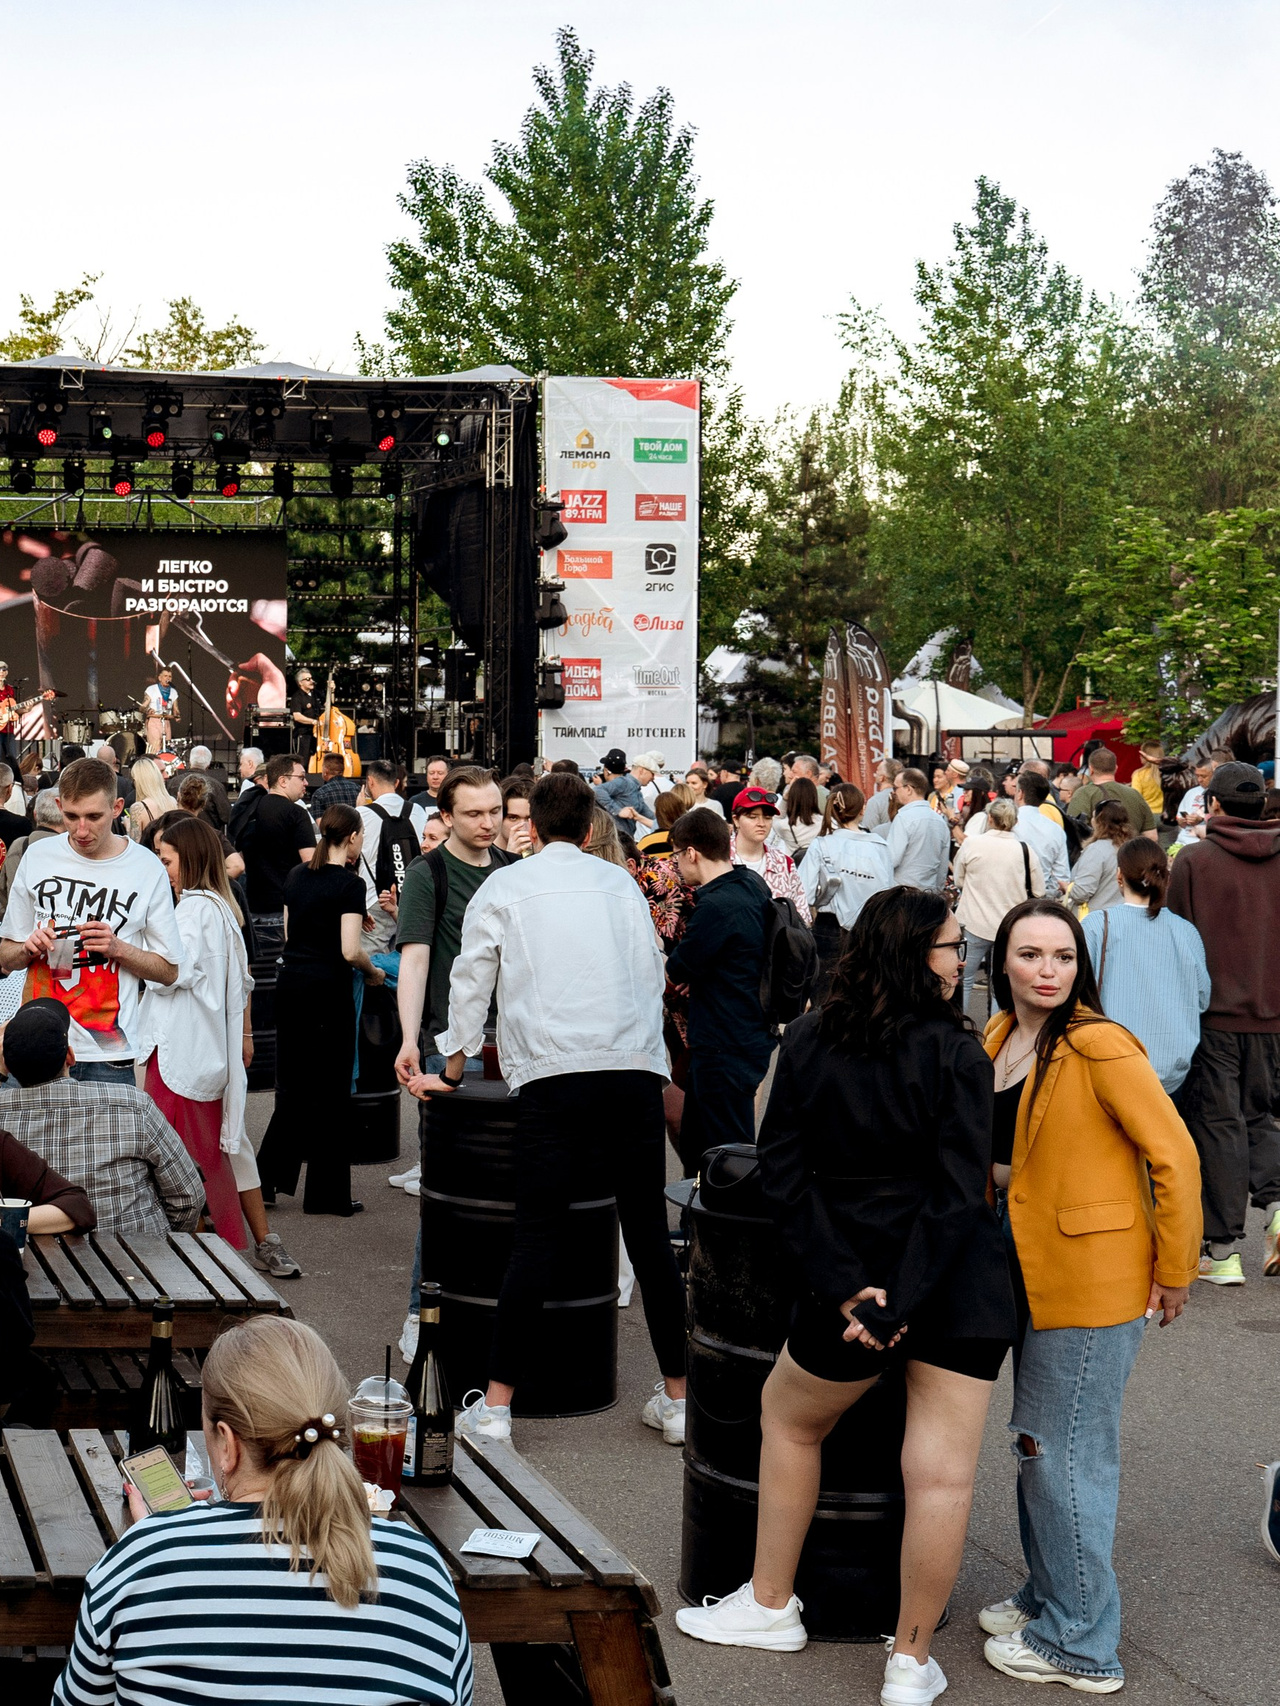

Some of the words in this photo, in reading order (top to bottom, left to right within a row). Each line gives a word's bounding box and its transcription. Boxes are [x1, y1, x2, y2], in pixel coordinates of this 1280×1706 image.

[639, 441, 662, 452] ТВОЙ
[663, 442, 683, 452] ДОМ
[560, 450, 611, 459] ЛЕМАНА
[572, 461, 597, 469] ПРО
[565, 494, 603, 508] JAZZ
[659, 502, 682, 511] НАШЕ
[565, 509, 586, 519] 89.1
[587, 509, 602, 519] FM
[564, 554, 603, 564] Большой
[157, 560, 213, 574] ЛЕГКО
[563, 565, 588, 573] Город
[141, 580, 154, 593] И
[158, 580, 229, 594] БЫСТРО
[645, 582, 675, 592] 2ГИС
[125, 598, 248, 613] РАЗГОРАЮТСЯ
[649, 616, 684, 631] Лиза
[564, 665, 598, 679] ИДЕИ
[565, 684, 599, 697] ДОМА
[627, 728, 686, 738] BUTCHER
